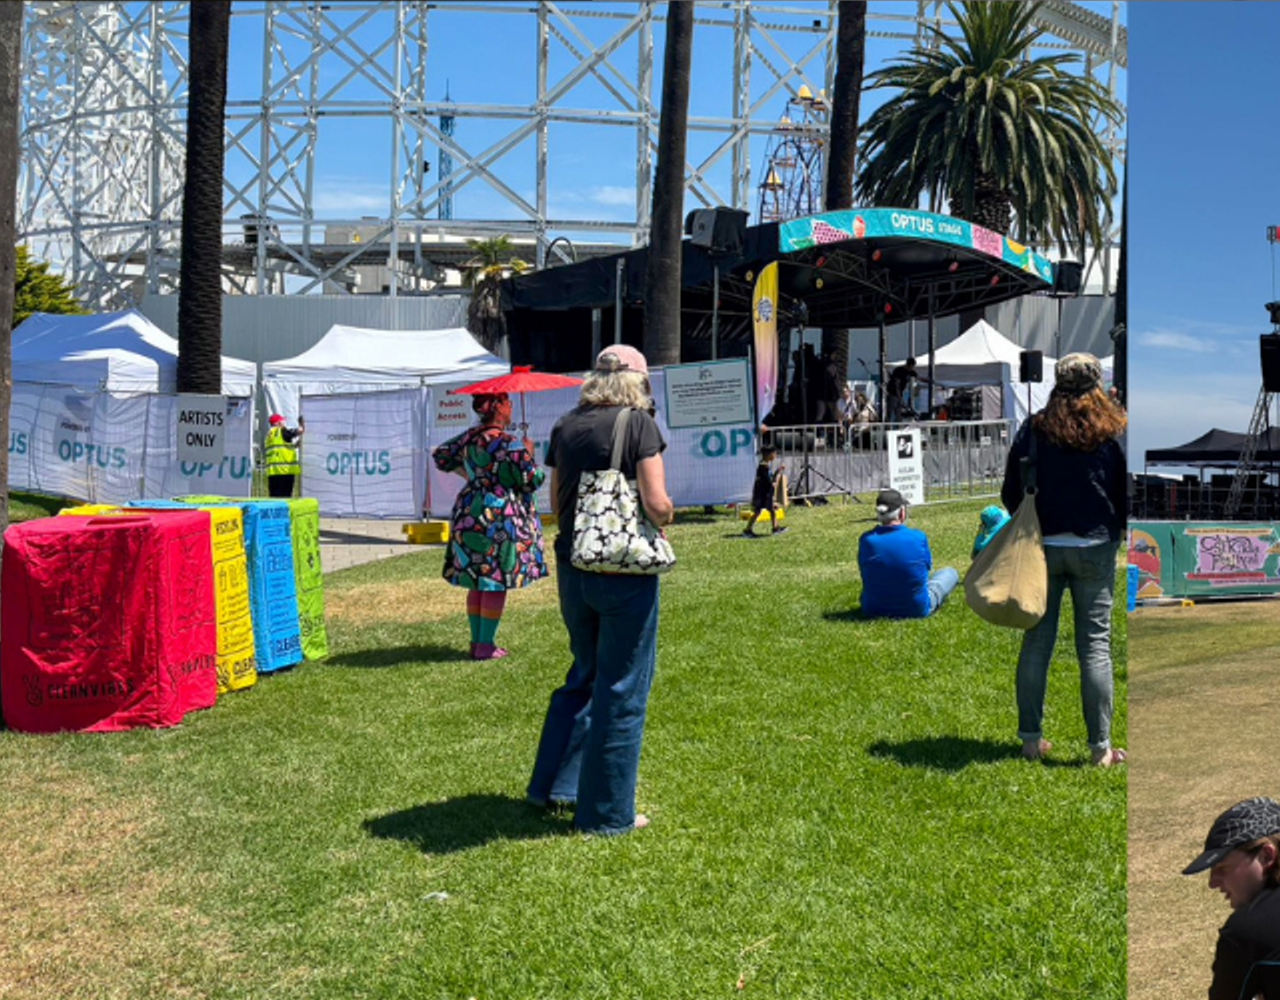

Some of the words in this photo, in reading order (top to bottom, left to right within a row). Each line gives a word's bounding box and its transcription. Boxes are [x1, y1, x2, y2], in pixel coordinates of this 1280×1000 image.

[891, 213, 934, 233] OPTUS
[938, 222, 962, 236] STAGE
[439, 399, 463, 408] Public
[179, 410, 223, 426] ARTISTS
[437, 412, 467, 421] Access
[186, 433, 216, 447] ONLY
[58, 439, 126, 469] OPTUS
[326, 450, 391, 476] OPTUS
